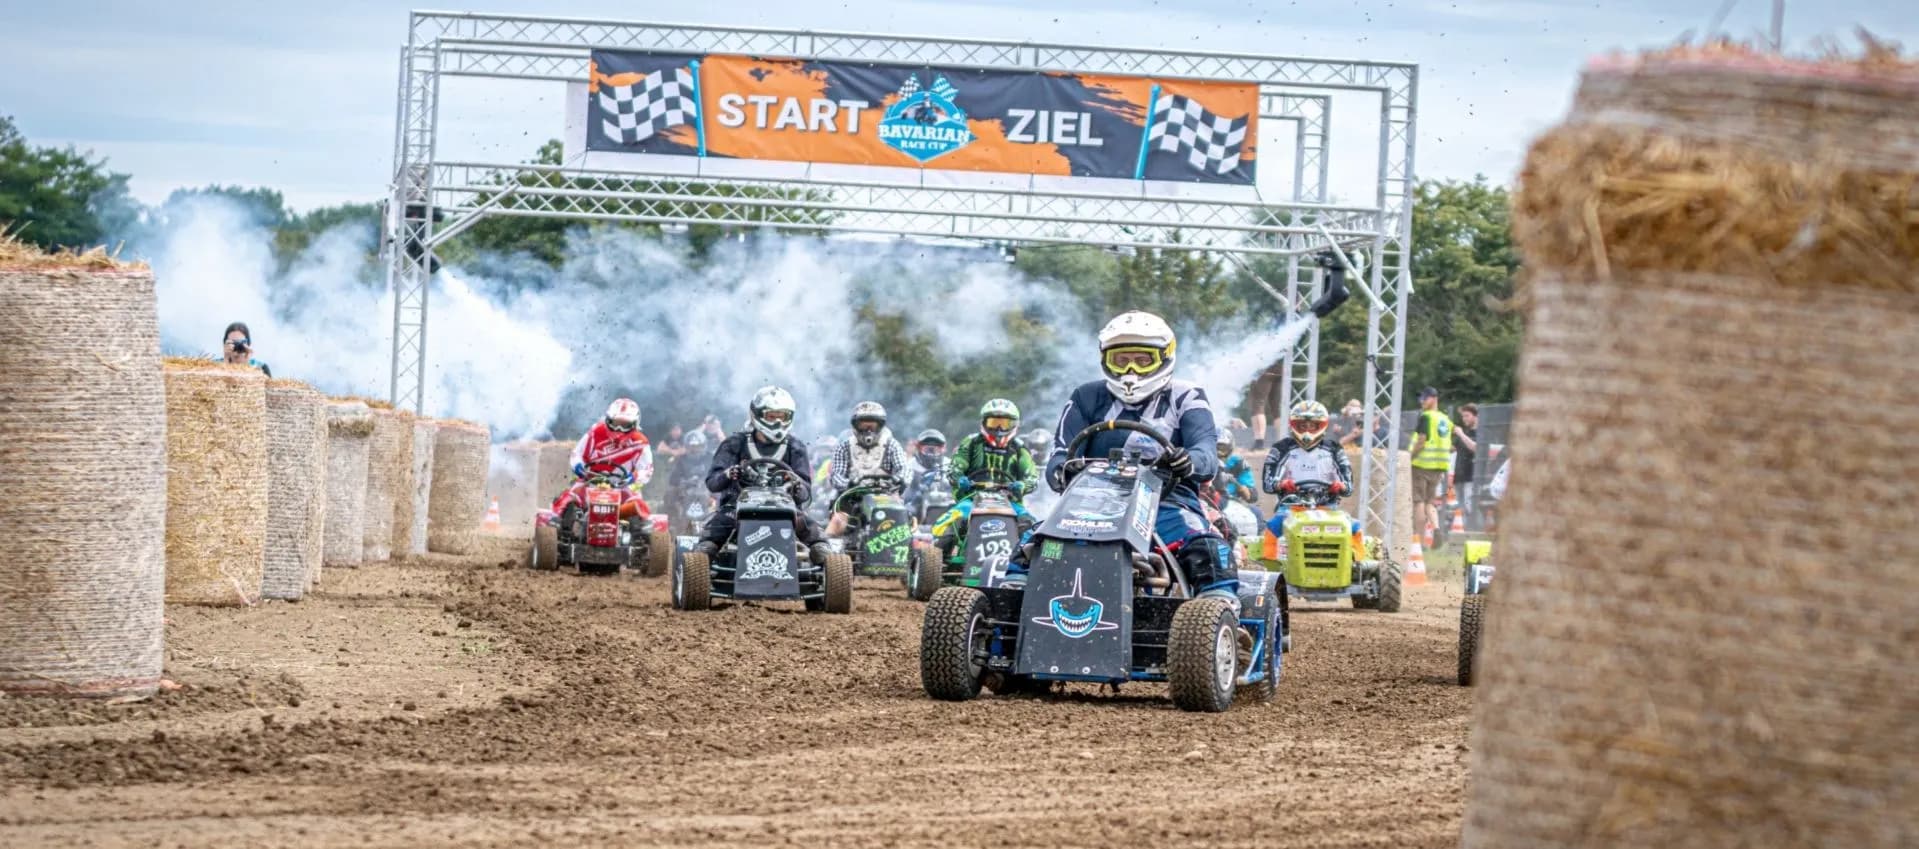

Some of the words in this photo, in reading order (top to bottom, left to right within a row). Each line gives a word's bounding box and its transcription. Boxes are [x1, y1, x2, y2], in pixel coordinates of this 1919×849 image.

[717, 92, 869, 136] START
[878, 124, 971, 145] BAVARIAN
[1006, 108, 1104, 148] ZIEL
[900, 140, 925, 150] RACE
[928, 141, 948, 151] CUP
[1060, 518, 1114, 528] KOHLER
